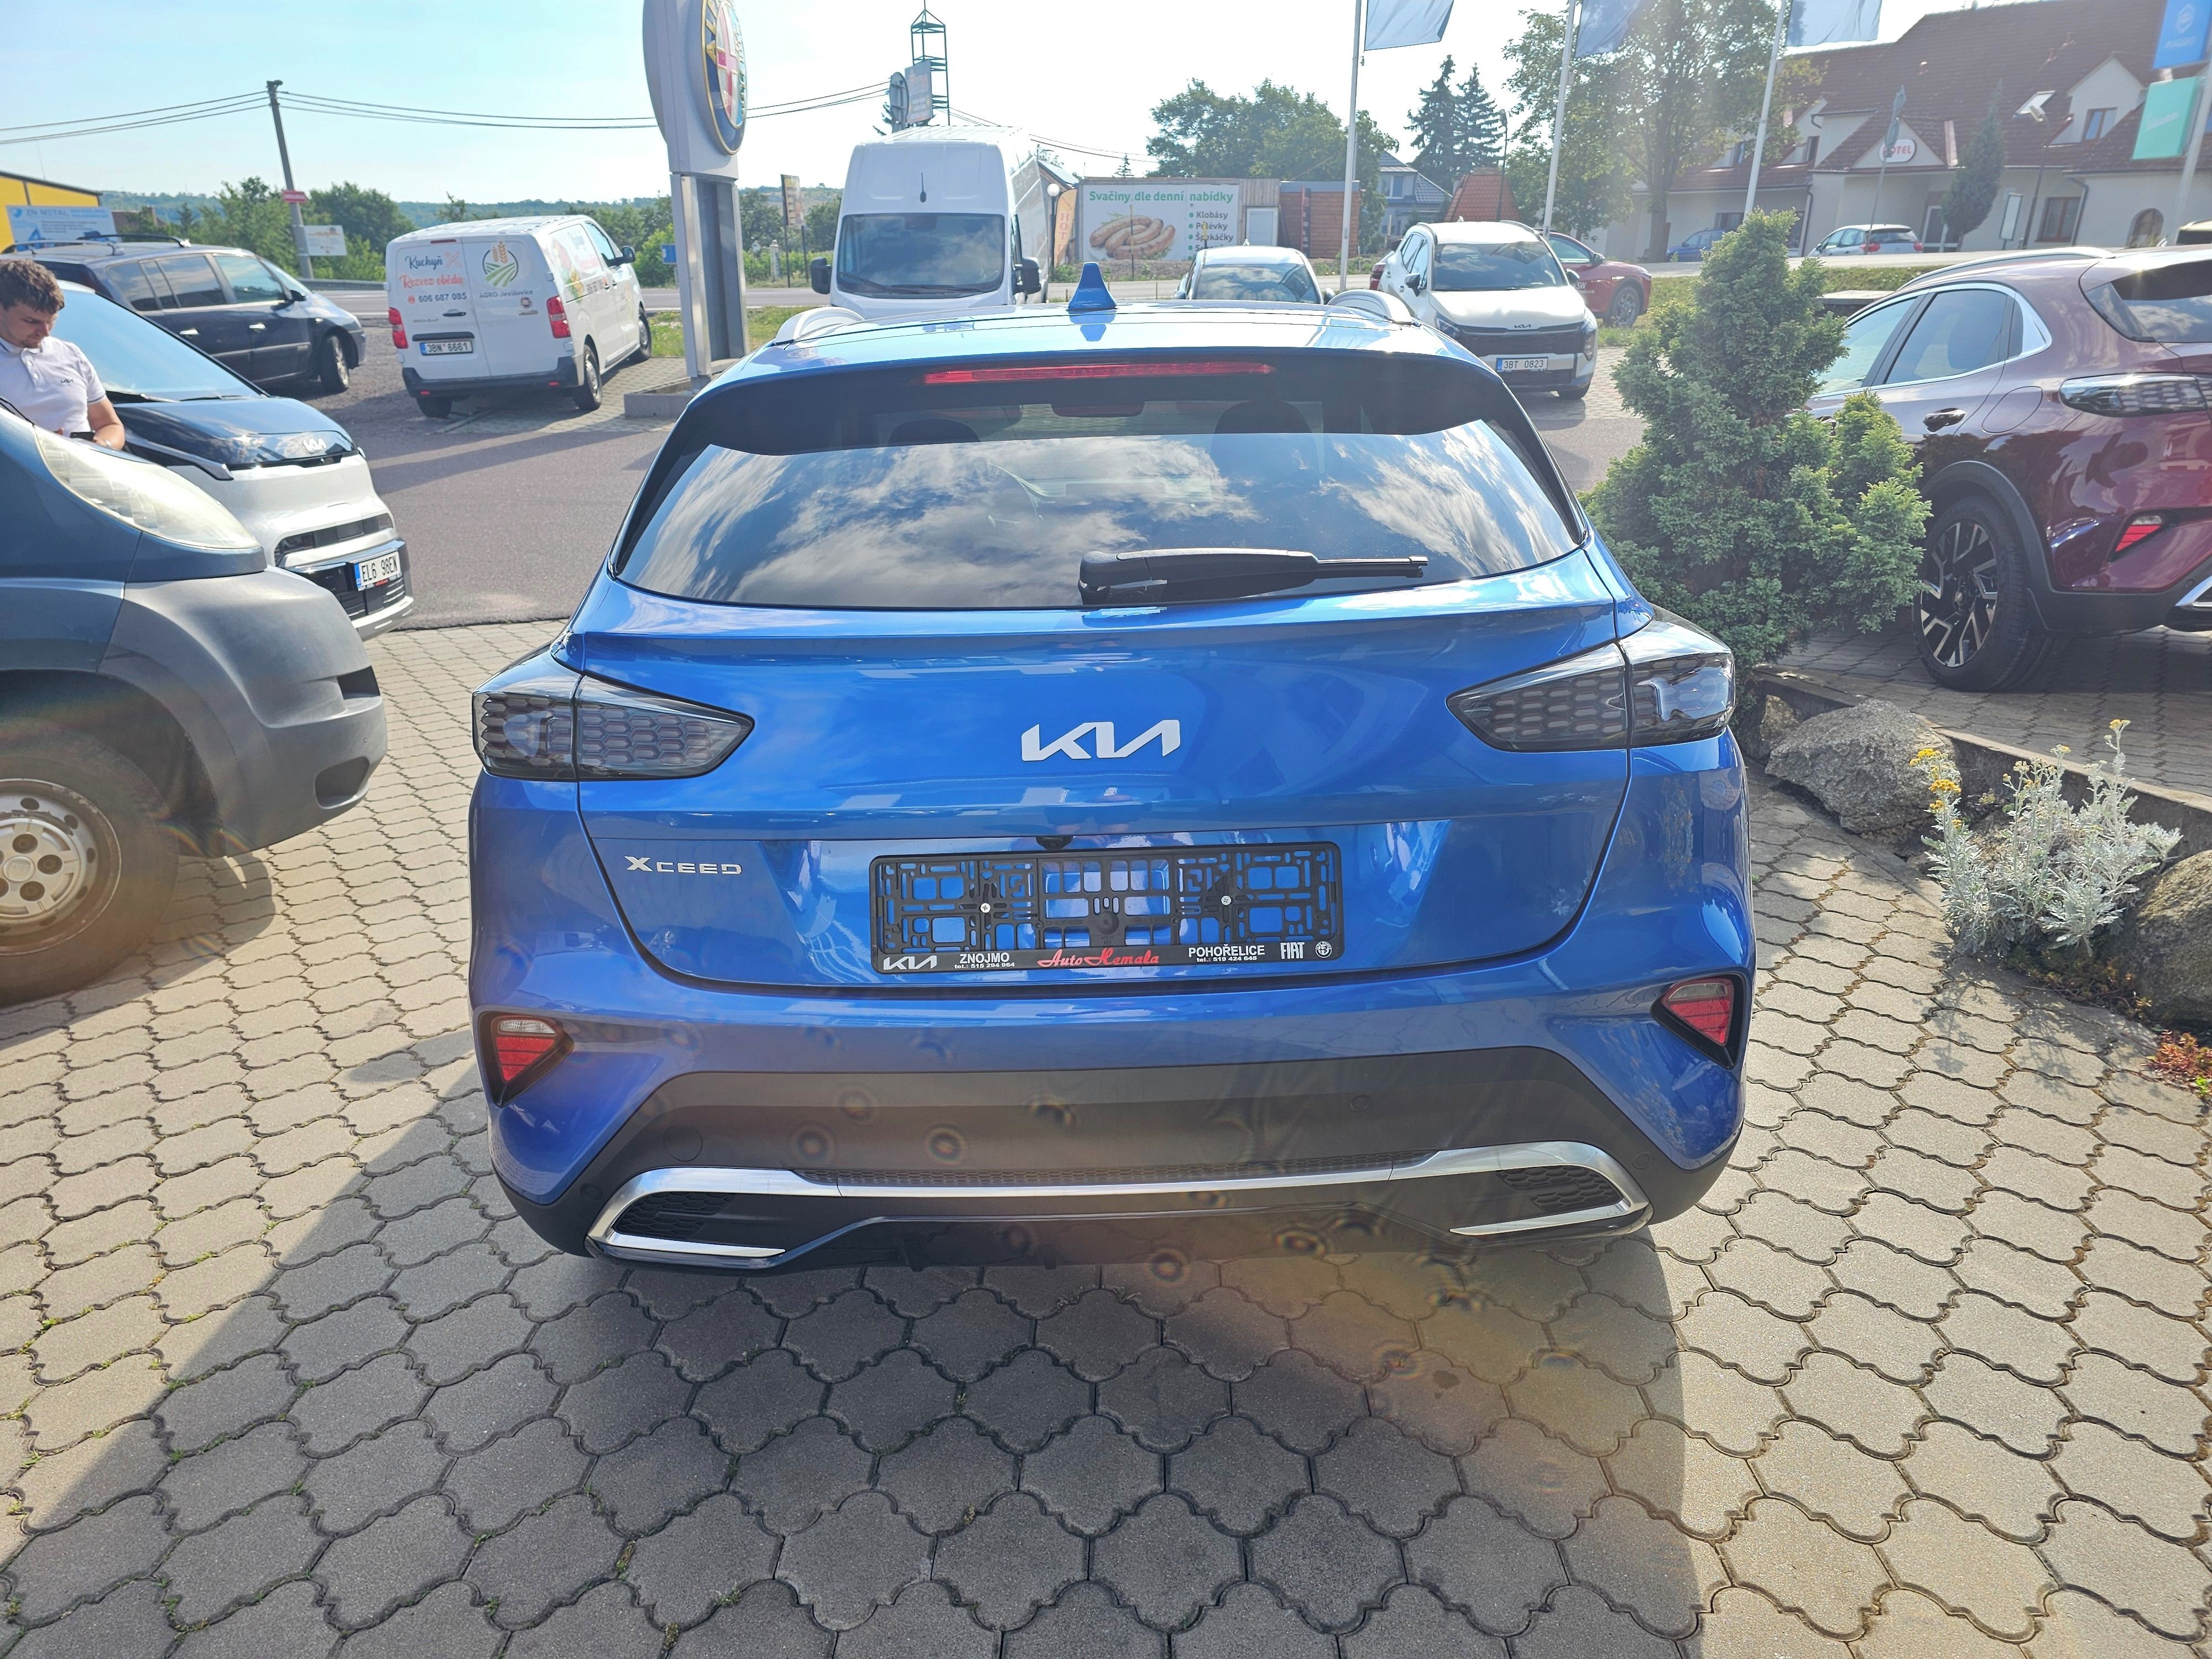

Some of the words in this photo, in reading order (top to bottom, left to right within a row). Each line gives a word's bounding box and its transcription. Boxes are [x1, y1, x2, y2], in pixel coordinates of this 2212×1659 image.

[1883, 146, 1911, 158] OTEL
[1089, 191, 1130, 204] Svačiny
[1135, 191, 1151, 201] dle
[1154, 191, 1184, 201] denní
[1190, 191, 1233, 204] nabídky
[1196, 211, 1228, 220] Klobásy
[405, 255, 442, 270] Kuchyň
[1524, 360, 1544, 368] 0823
[362, 563, 377, 581] EL6
[1021, 719, 1181, 762] KIA
[1188, 943, 1265, 957] POHOŘELICE
[1280, 942, 1305, 959] FIAT
[883, 955, 937, 970] KIA
[959, 952, 1010, 964] ZNOJMO
